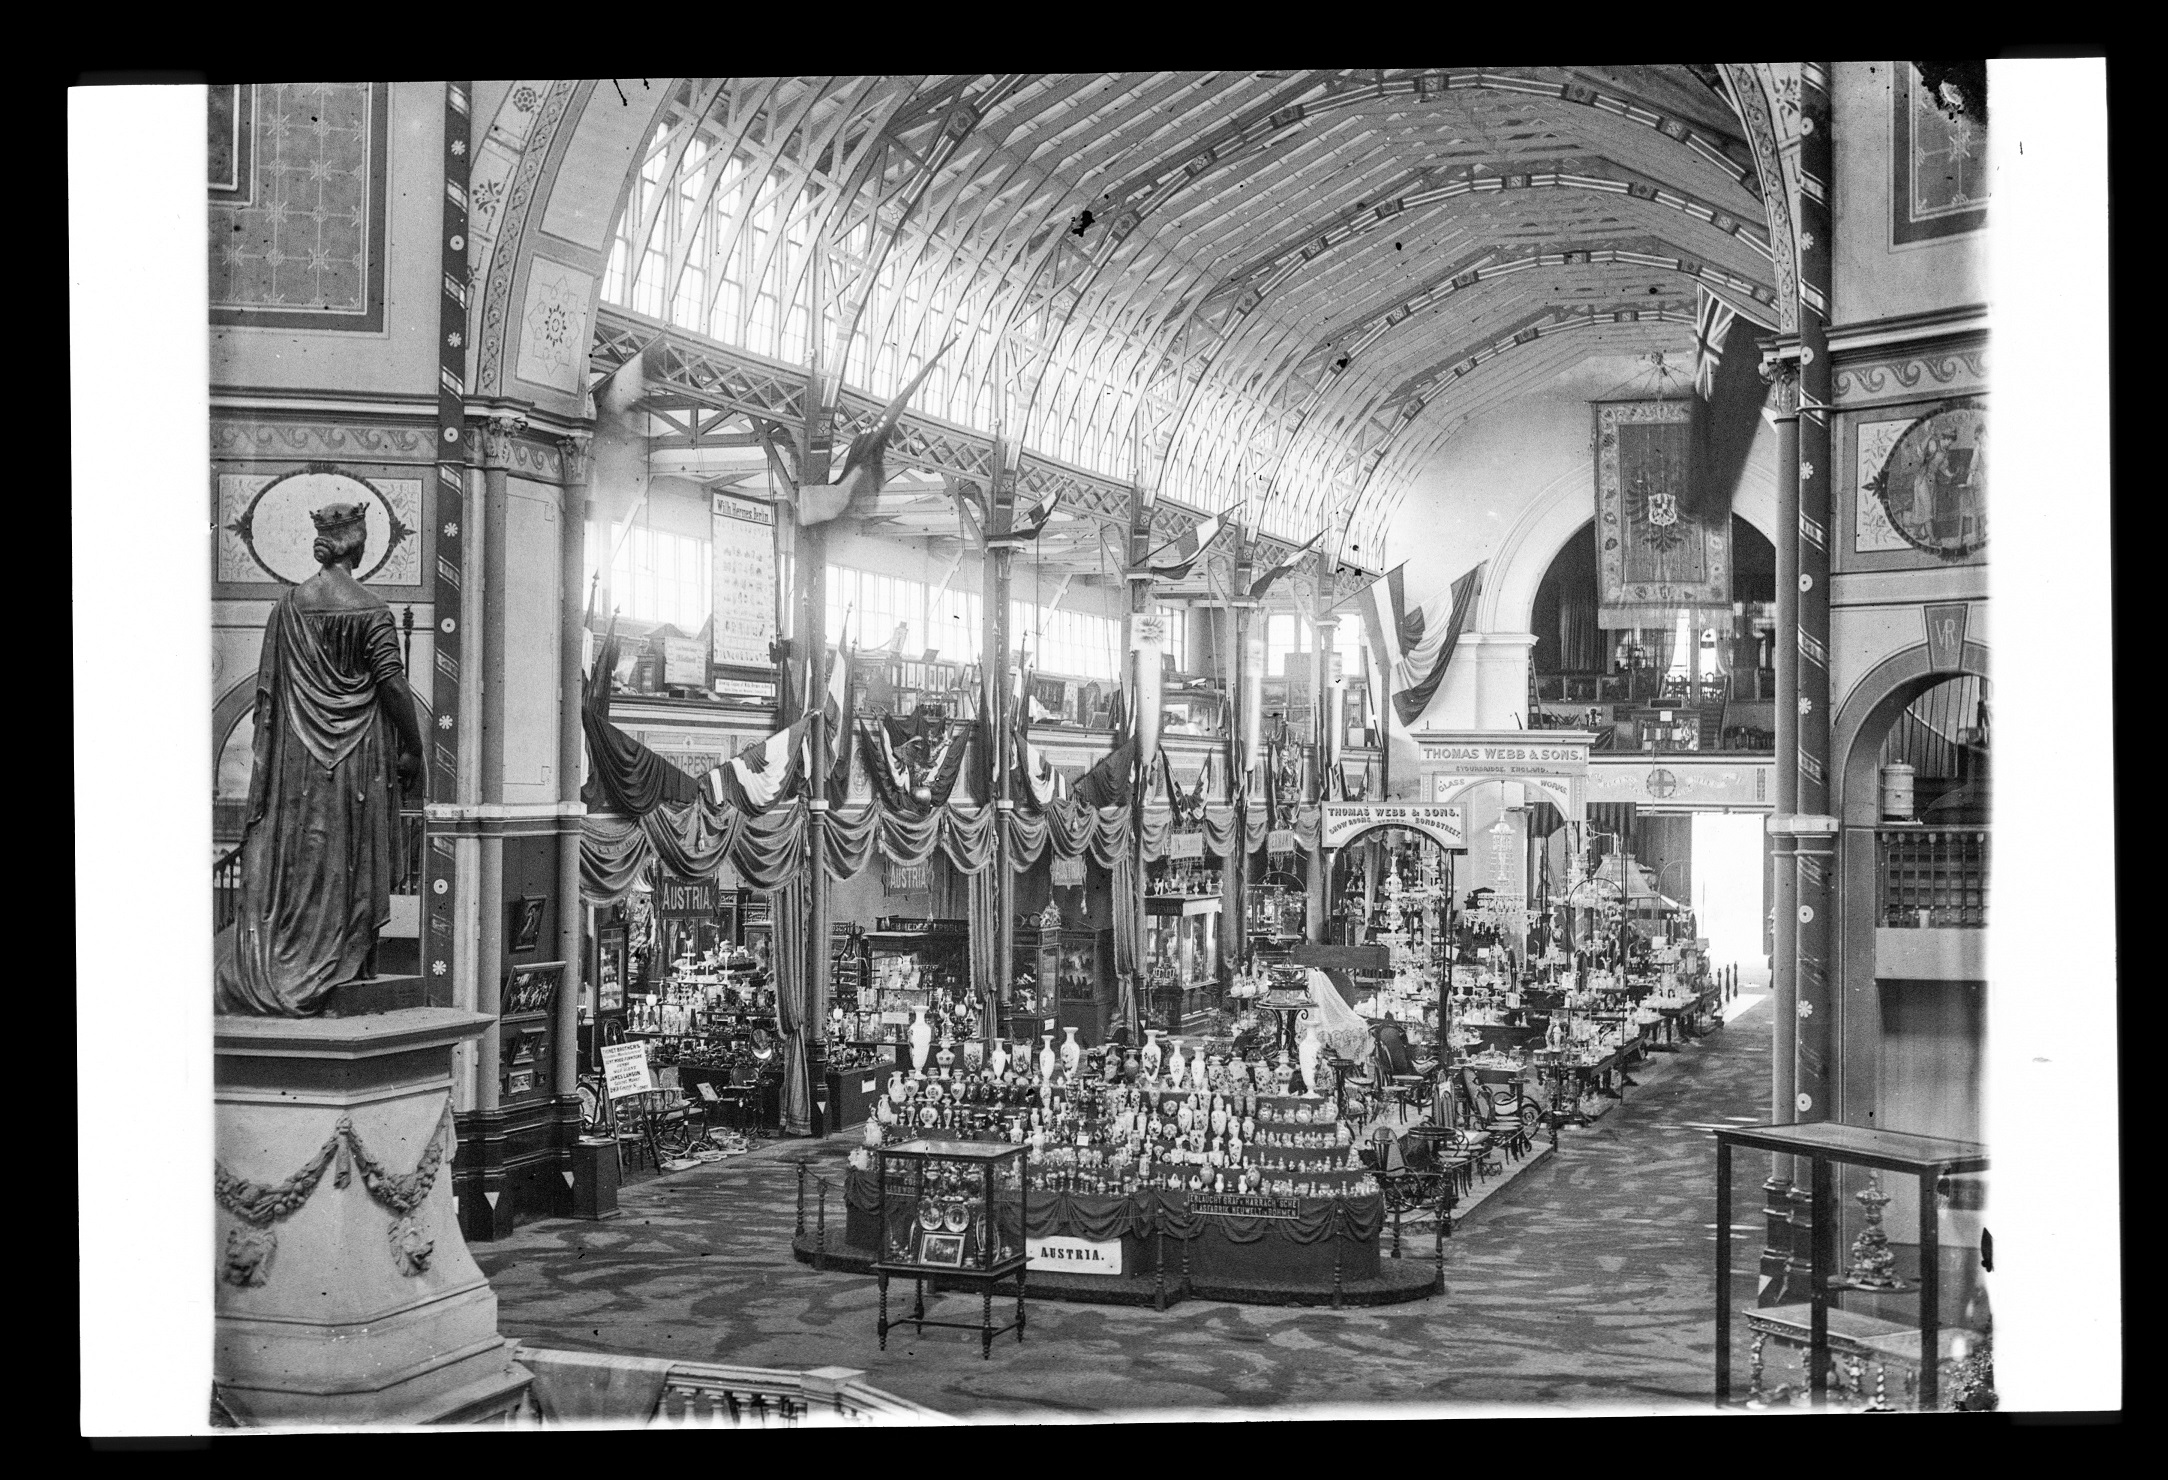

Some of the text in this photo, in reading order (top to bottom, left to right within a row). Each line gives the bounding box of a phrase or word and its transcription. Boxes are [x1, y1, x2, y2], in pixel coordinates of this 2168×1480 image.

[1935, 619, 1955, 650] VR
[1424, 748, 1582, 760] THOMAS WEBB & SONS.
[1438, 778, 1465, 792] GLASS
[1328, 808, 1460, 817] THOMAS WEBB & SONS.
[1223, 1196, 1240, 1205] GRAF
[1040, 1246, 1104, 1261] AUSTRIA.
